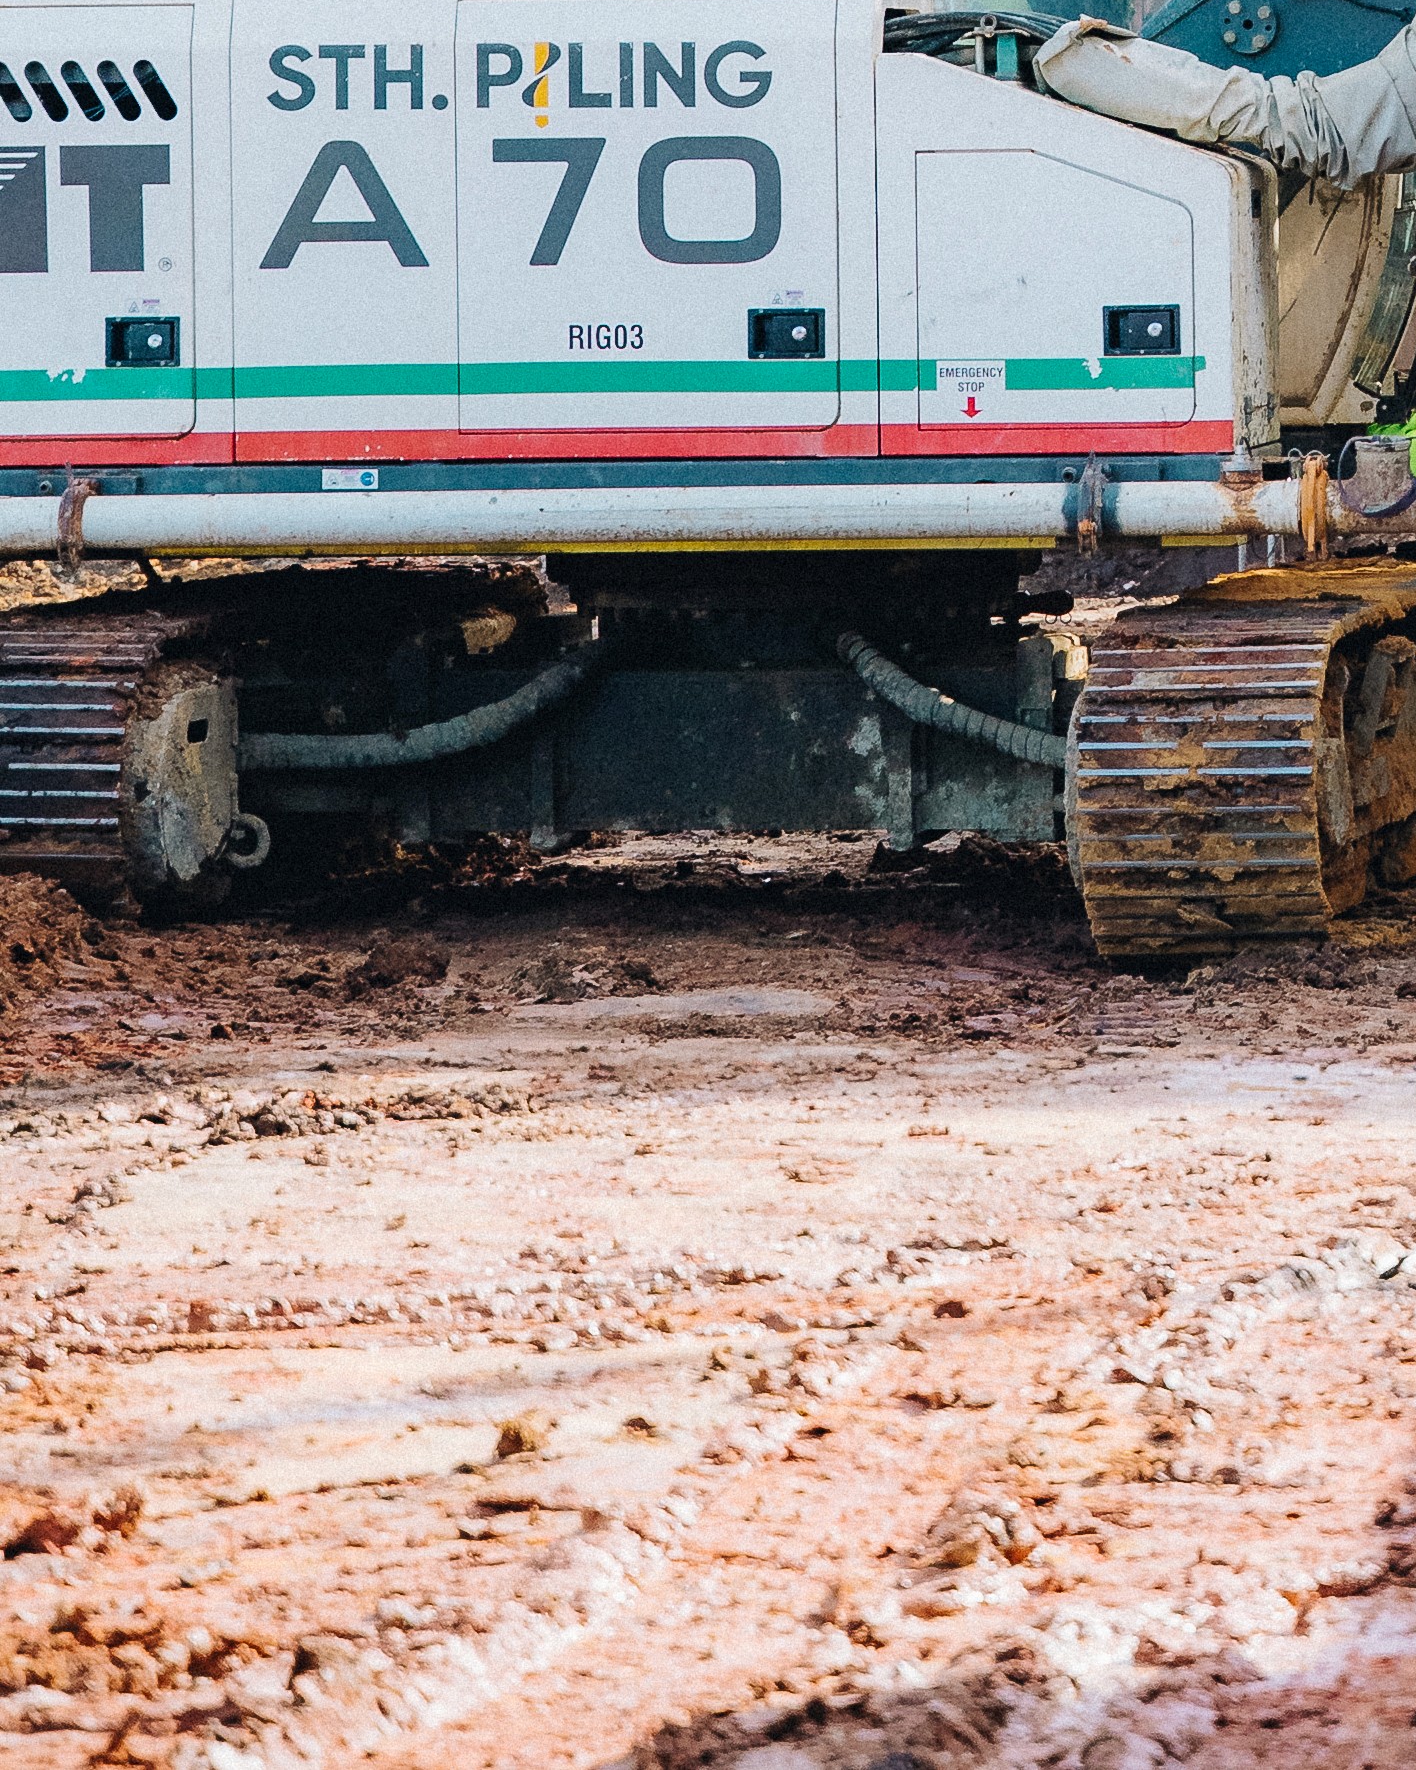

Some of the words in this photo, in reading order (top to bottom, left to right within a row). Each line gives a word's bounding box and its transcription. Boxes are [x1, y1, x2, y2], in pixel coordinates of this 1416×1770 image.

[266, 44, 450, 112] STH.
[475, 39, 774, 128] PILING
[568, 323, 645, 351] RIG03
[938, 366, 1004, 379] EMERGENCY
[957, 381, 985, 393] STOP
